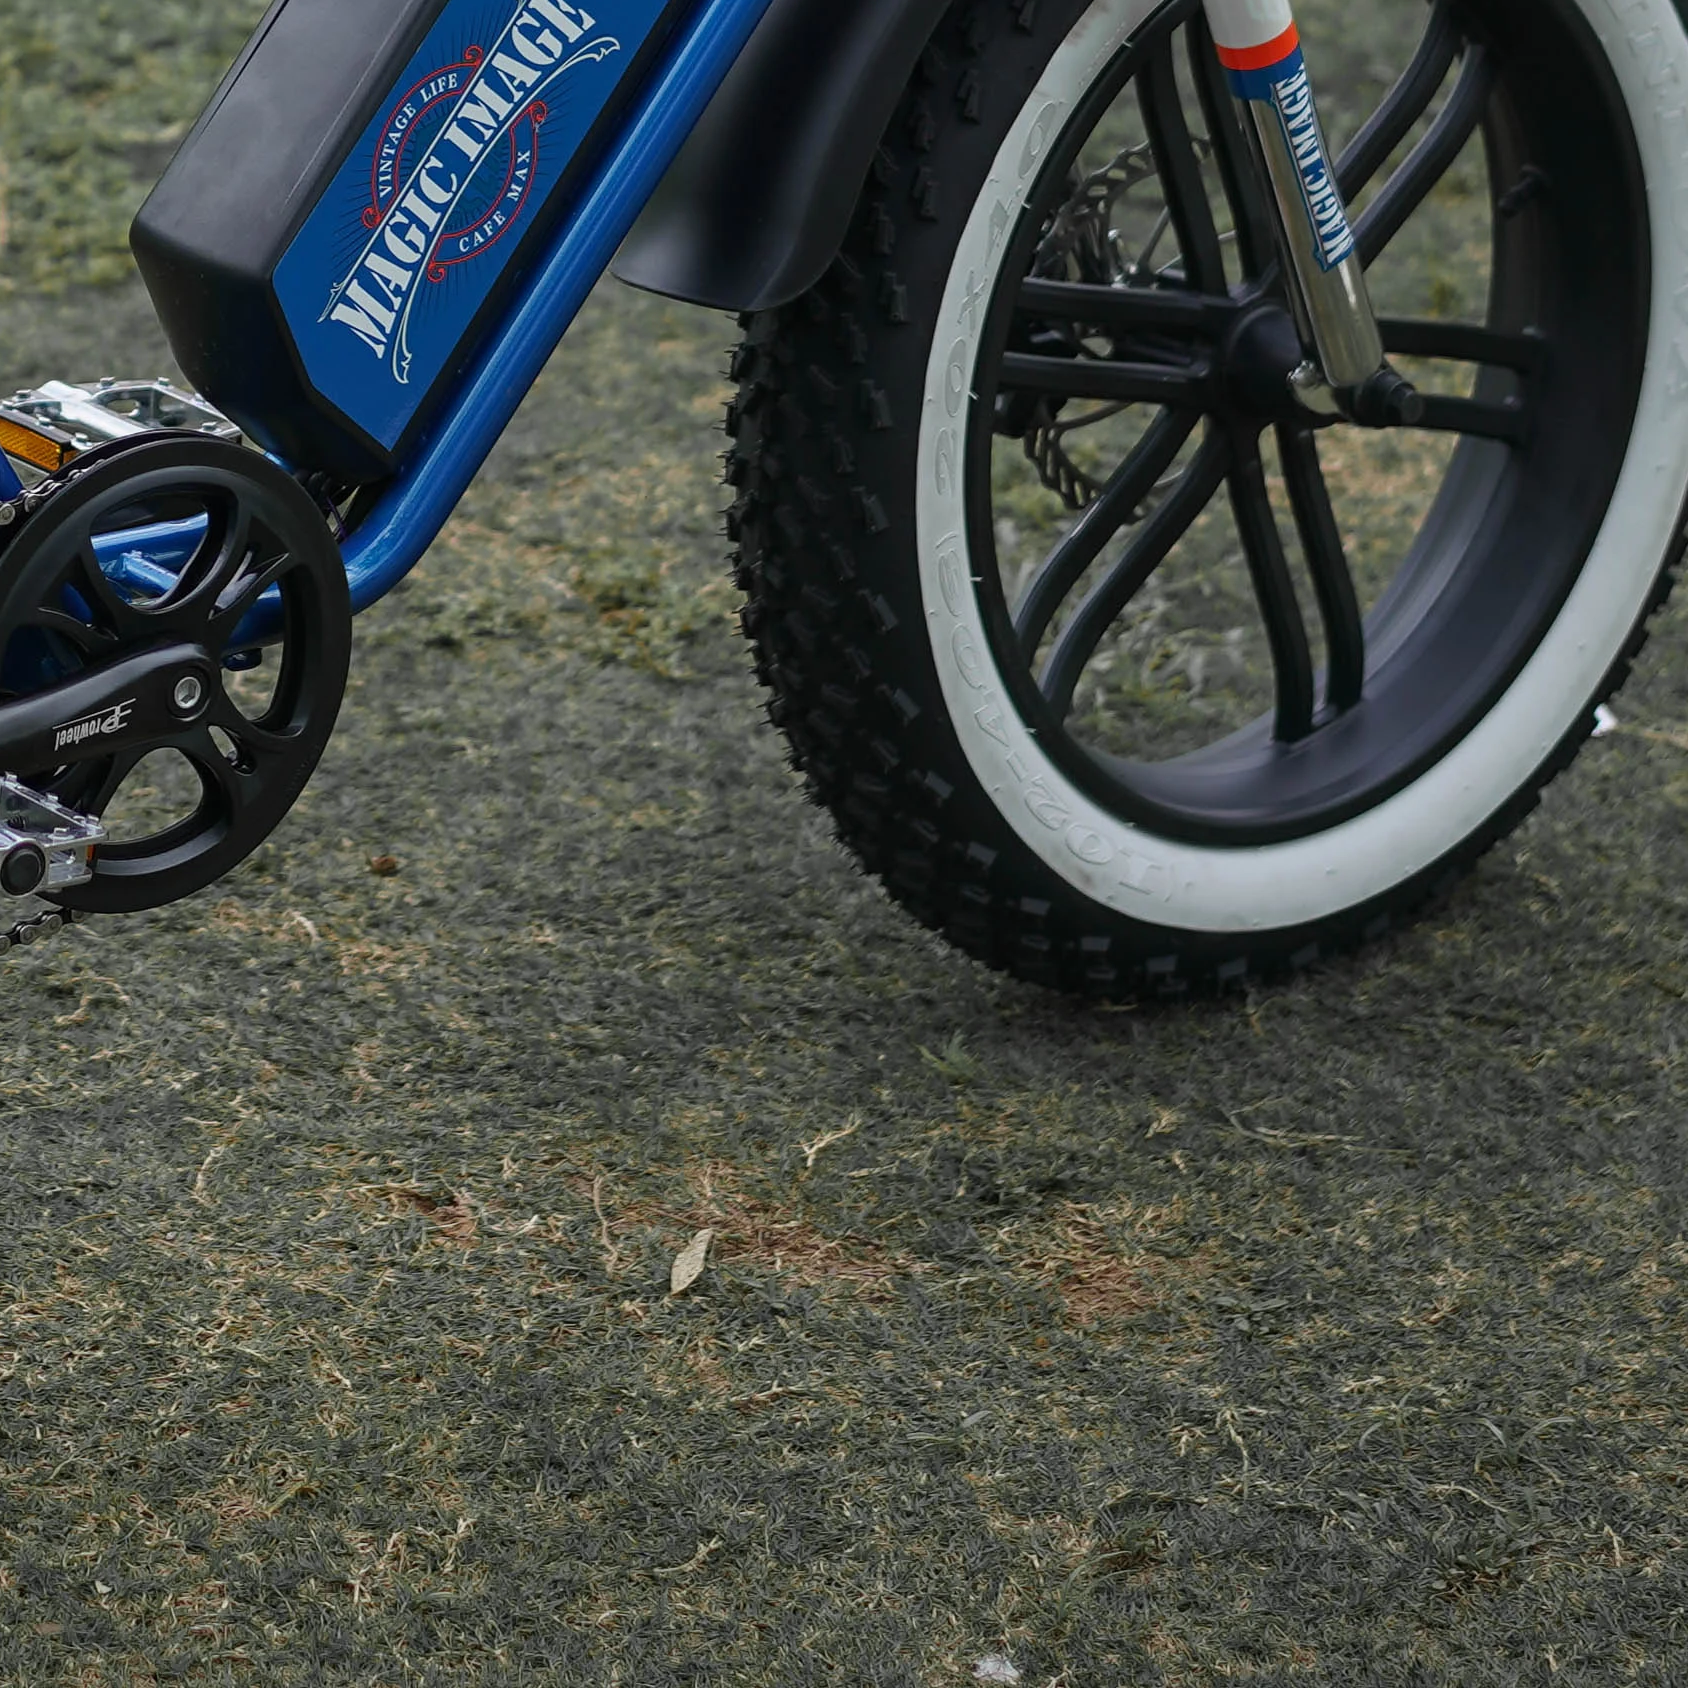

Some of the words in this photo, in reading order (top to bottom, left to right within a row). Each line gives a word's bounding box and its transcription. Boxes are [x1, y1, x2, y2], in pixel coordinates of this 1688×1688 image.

[378, 104, 417, 198] VINTAGE
[419, 71, 459, 102] LIFE
[458, 210, 506, 254] CAFE
[507, 150, 532, 202] MAX
[1304, 166, 1355, 263] MAGIC
[330, 156, 459, 359] MAGIC
[53, 701, 135, 752] Prowheel
